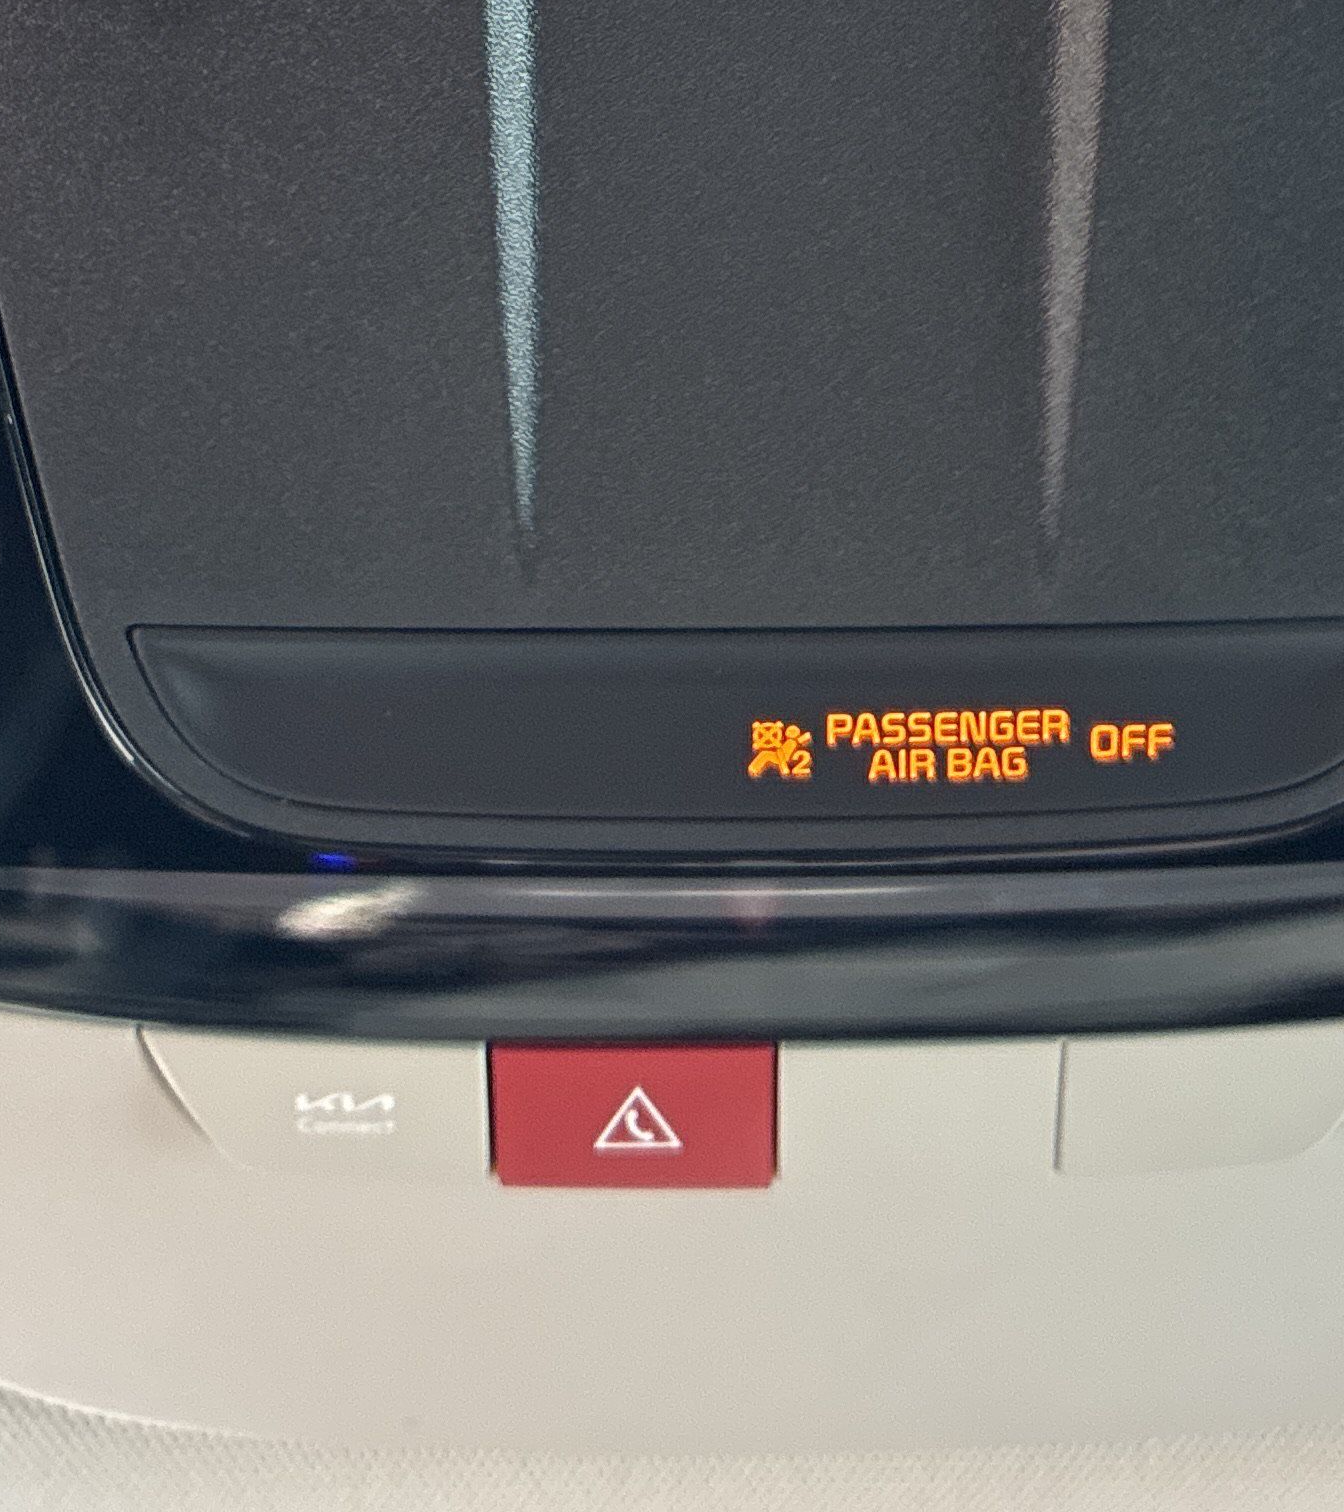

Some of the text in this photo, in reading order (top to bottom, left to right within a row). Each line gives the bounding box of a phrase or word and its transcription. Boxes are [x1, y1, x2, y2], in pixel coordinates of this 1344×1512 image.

[825, 710, 1071, 747] PASSENGER
[1089, 723, 1174, 762] OFF
[791, 749, 812, 778] 2
[867, 745, 1029, 782] AIR BAG
[297, 1118, 394, 1134] Connect
